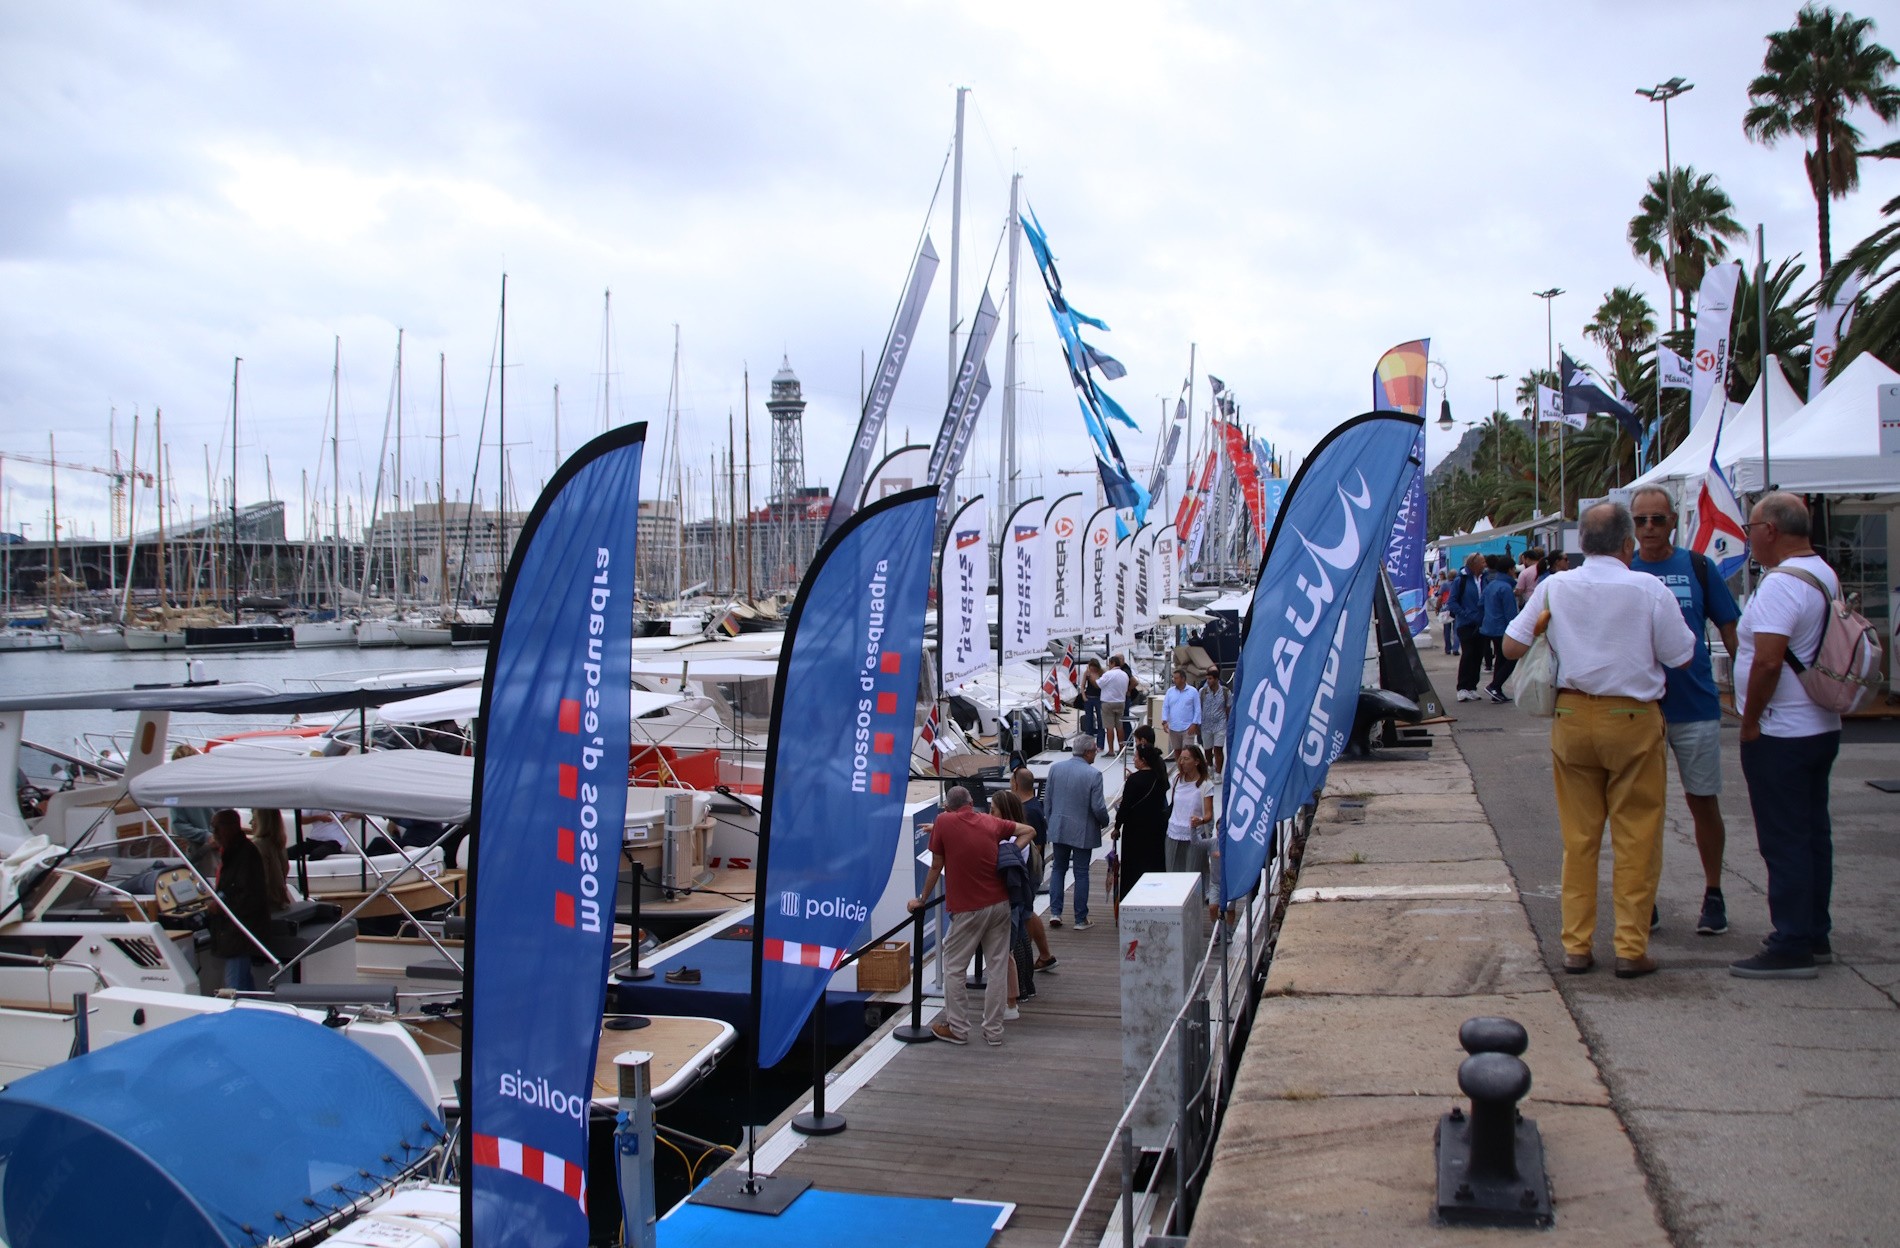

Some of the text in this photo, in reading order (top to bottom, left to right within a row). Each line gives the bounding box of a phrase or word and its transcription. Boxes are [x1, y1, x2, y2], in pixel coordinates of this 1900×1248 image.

[860, 333, 907, 450] BENETEAU
[927, 360, 975, 486] BENETEAU
[936, 393, 981, 520] ENETEAU
[1054, 540, 1066, 618] PARKER
[1094, 548, 1103, 618] PARKER
[1136, 545, 1150, 617] Windy
[1400, 535, 1413, 577] Yacht
[1656, 574, 1690, 585] DER
[851, 559, 888, 793] mossos d'esquadra
[1252, 794, 1274, 846] boats
[806, 897, 867, 922] policia
